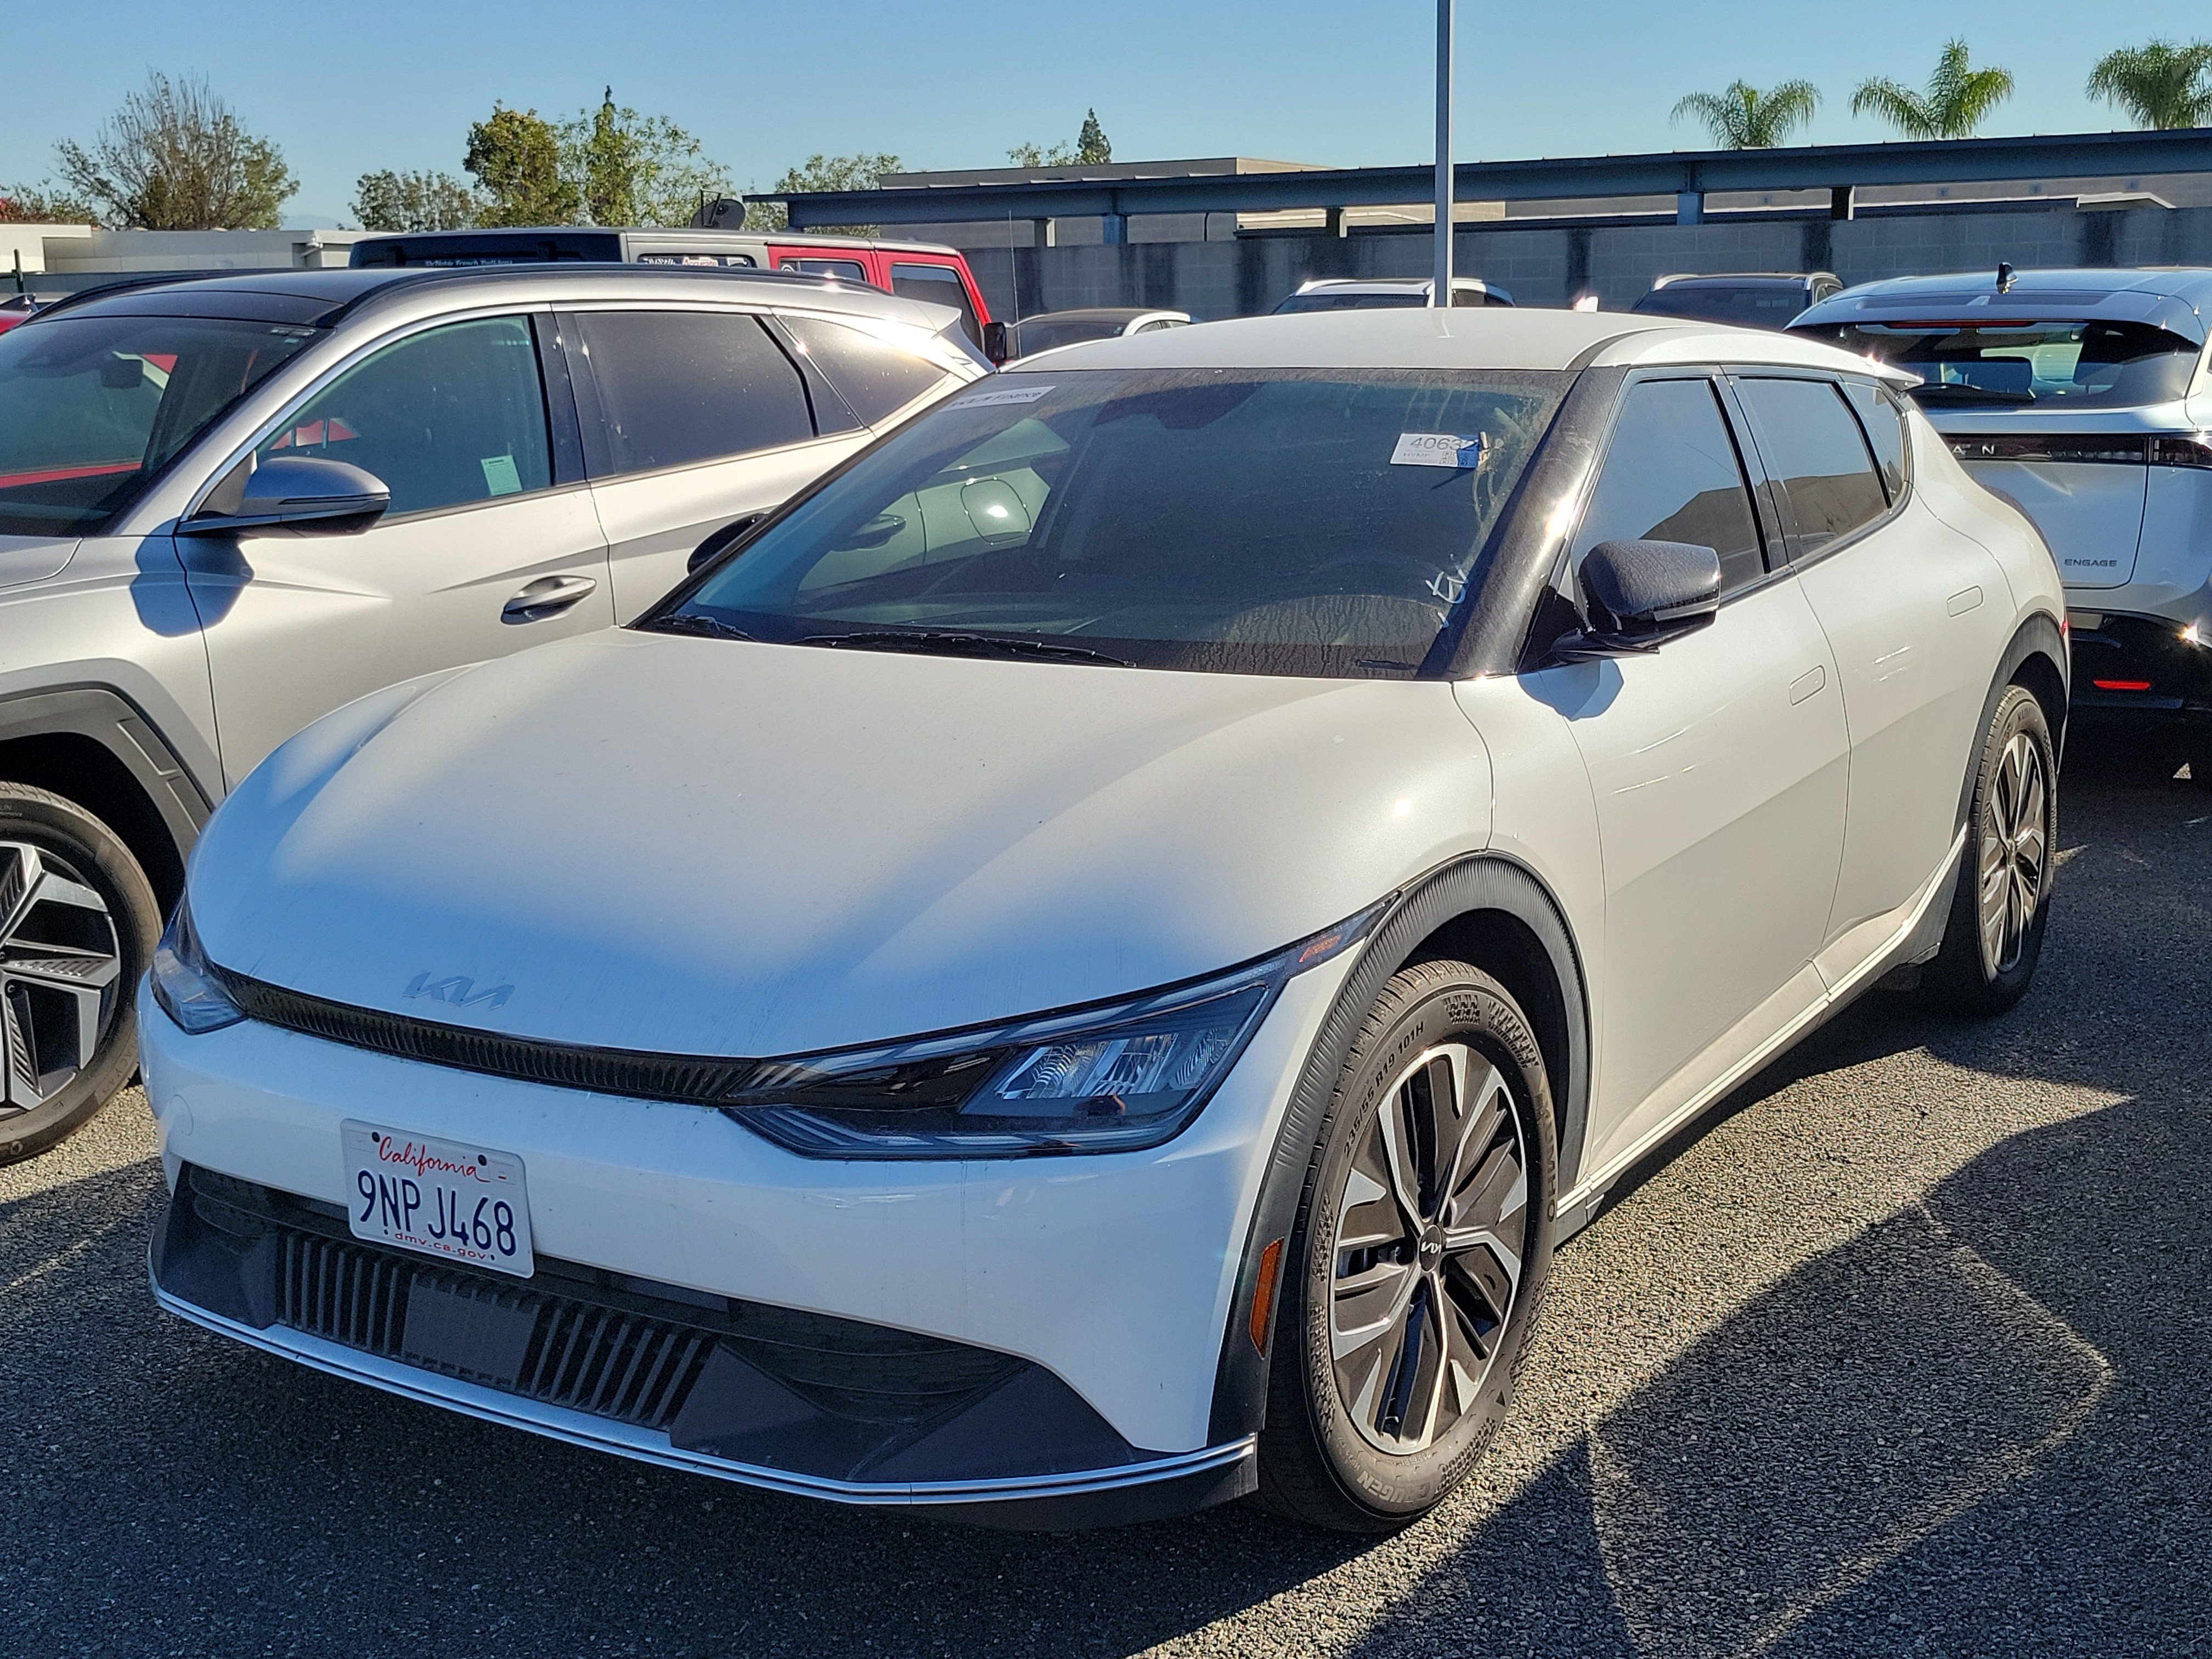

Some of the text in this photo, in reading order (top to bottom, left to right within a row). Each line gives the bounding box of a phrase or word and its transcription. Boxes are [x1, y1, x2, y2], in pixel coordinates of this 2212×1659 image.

[2064, 558, 2118, 567] ENGAGE
[402, 970, 516, 1012] KIA
[379, 1136, 491, 1183] California
[357, 1169, 517, 1257] 9NPJ468
[394, 1232, 487, 1261] dmv.ca.gov
